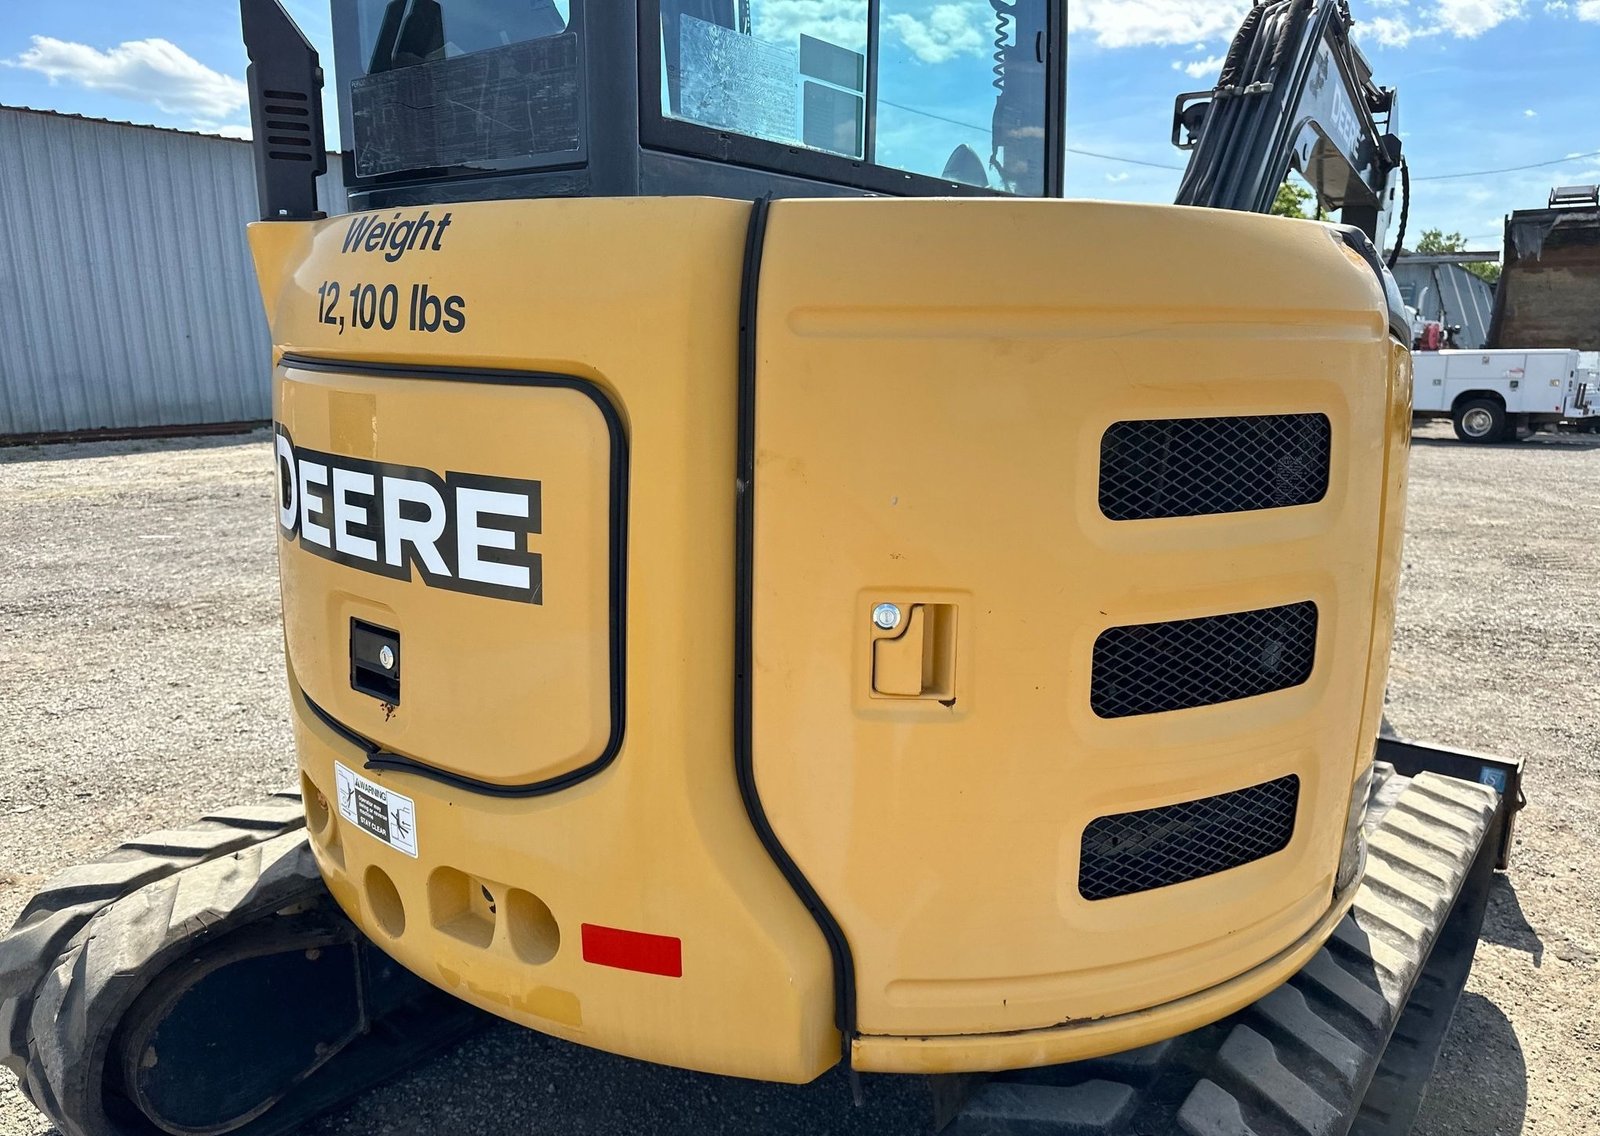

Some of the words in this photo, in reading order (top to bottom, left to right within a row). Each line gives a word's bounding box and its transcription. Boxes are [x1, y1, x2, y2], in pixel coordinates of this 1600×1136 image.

[341, 211, 452, 262] Weight
[318, 281, 399, 335] 12,100
[409, 284, 466, 333] lbs
[276, 433, 530, 589] DEERE
[359, 780, 387, 801] WARNING
[360, 816, 371, 828] STAY
[371, 822, 387, 836] CLEAR
